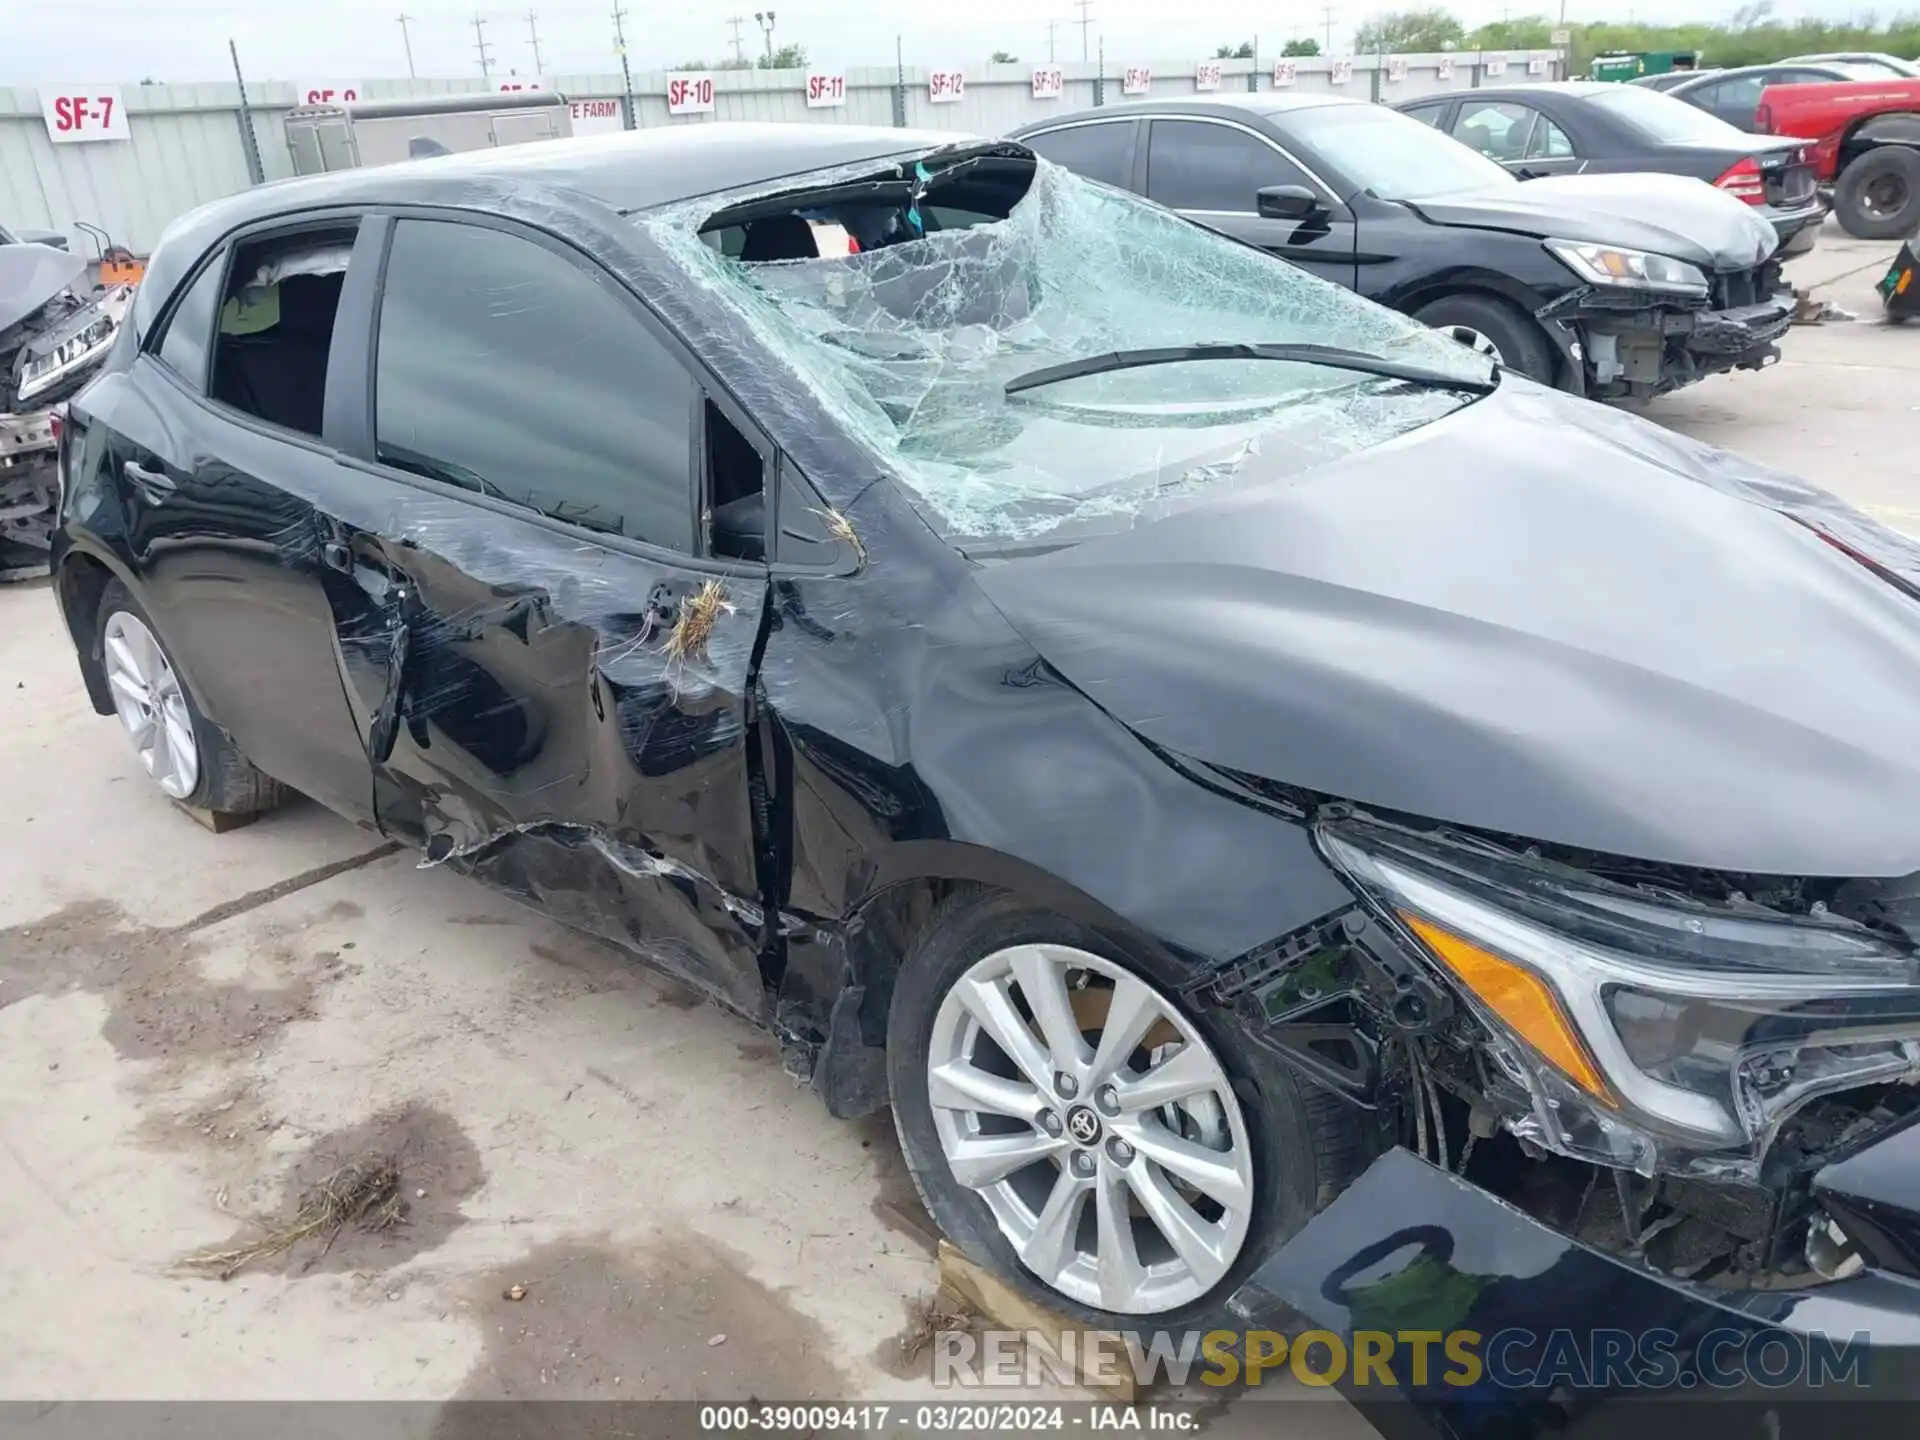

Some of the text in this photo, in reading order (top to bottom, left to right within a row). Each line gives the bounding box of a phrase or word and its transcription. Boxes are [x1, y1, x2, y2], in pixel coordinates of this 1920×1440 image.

[931, 73, 962, 95] SF-12
[1034, 71, 1062, 92] SF-13
[1125, 69, 1149, 88] SF-14
[1199, 66, 1220, 85] SF-15
[669, 79, 712, 105] SF-10
[809, 76, 843, 99] SF-11
[55, 96, 113, 131] SF-7
[583, 102, 616, 119] FARM
